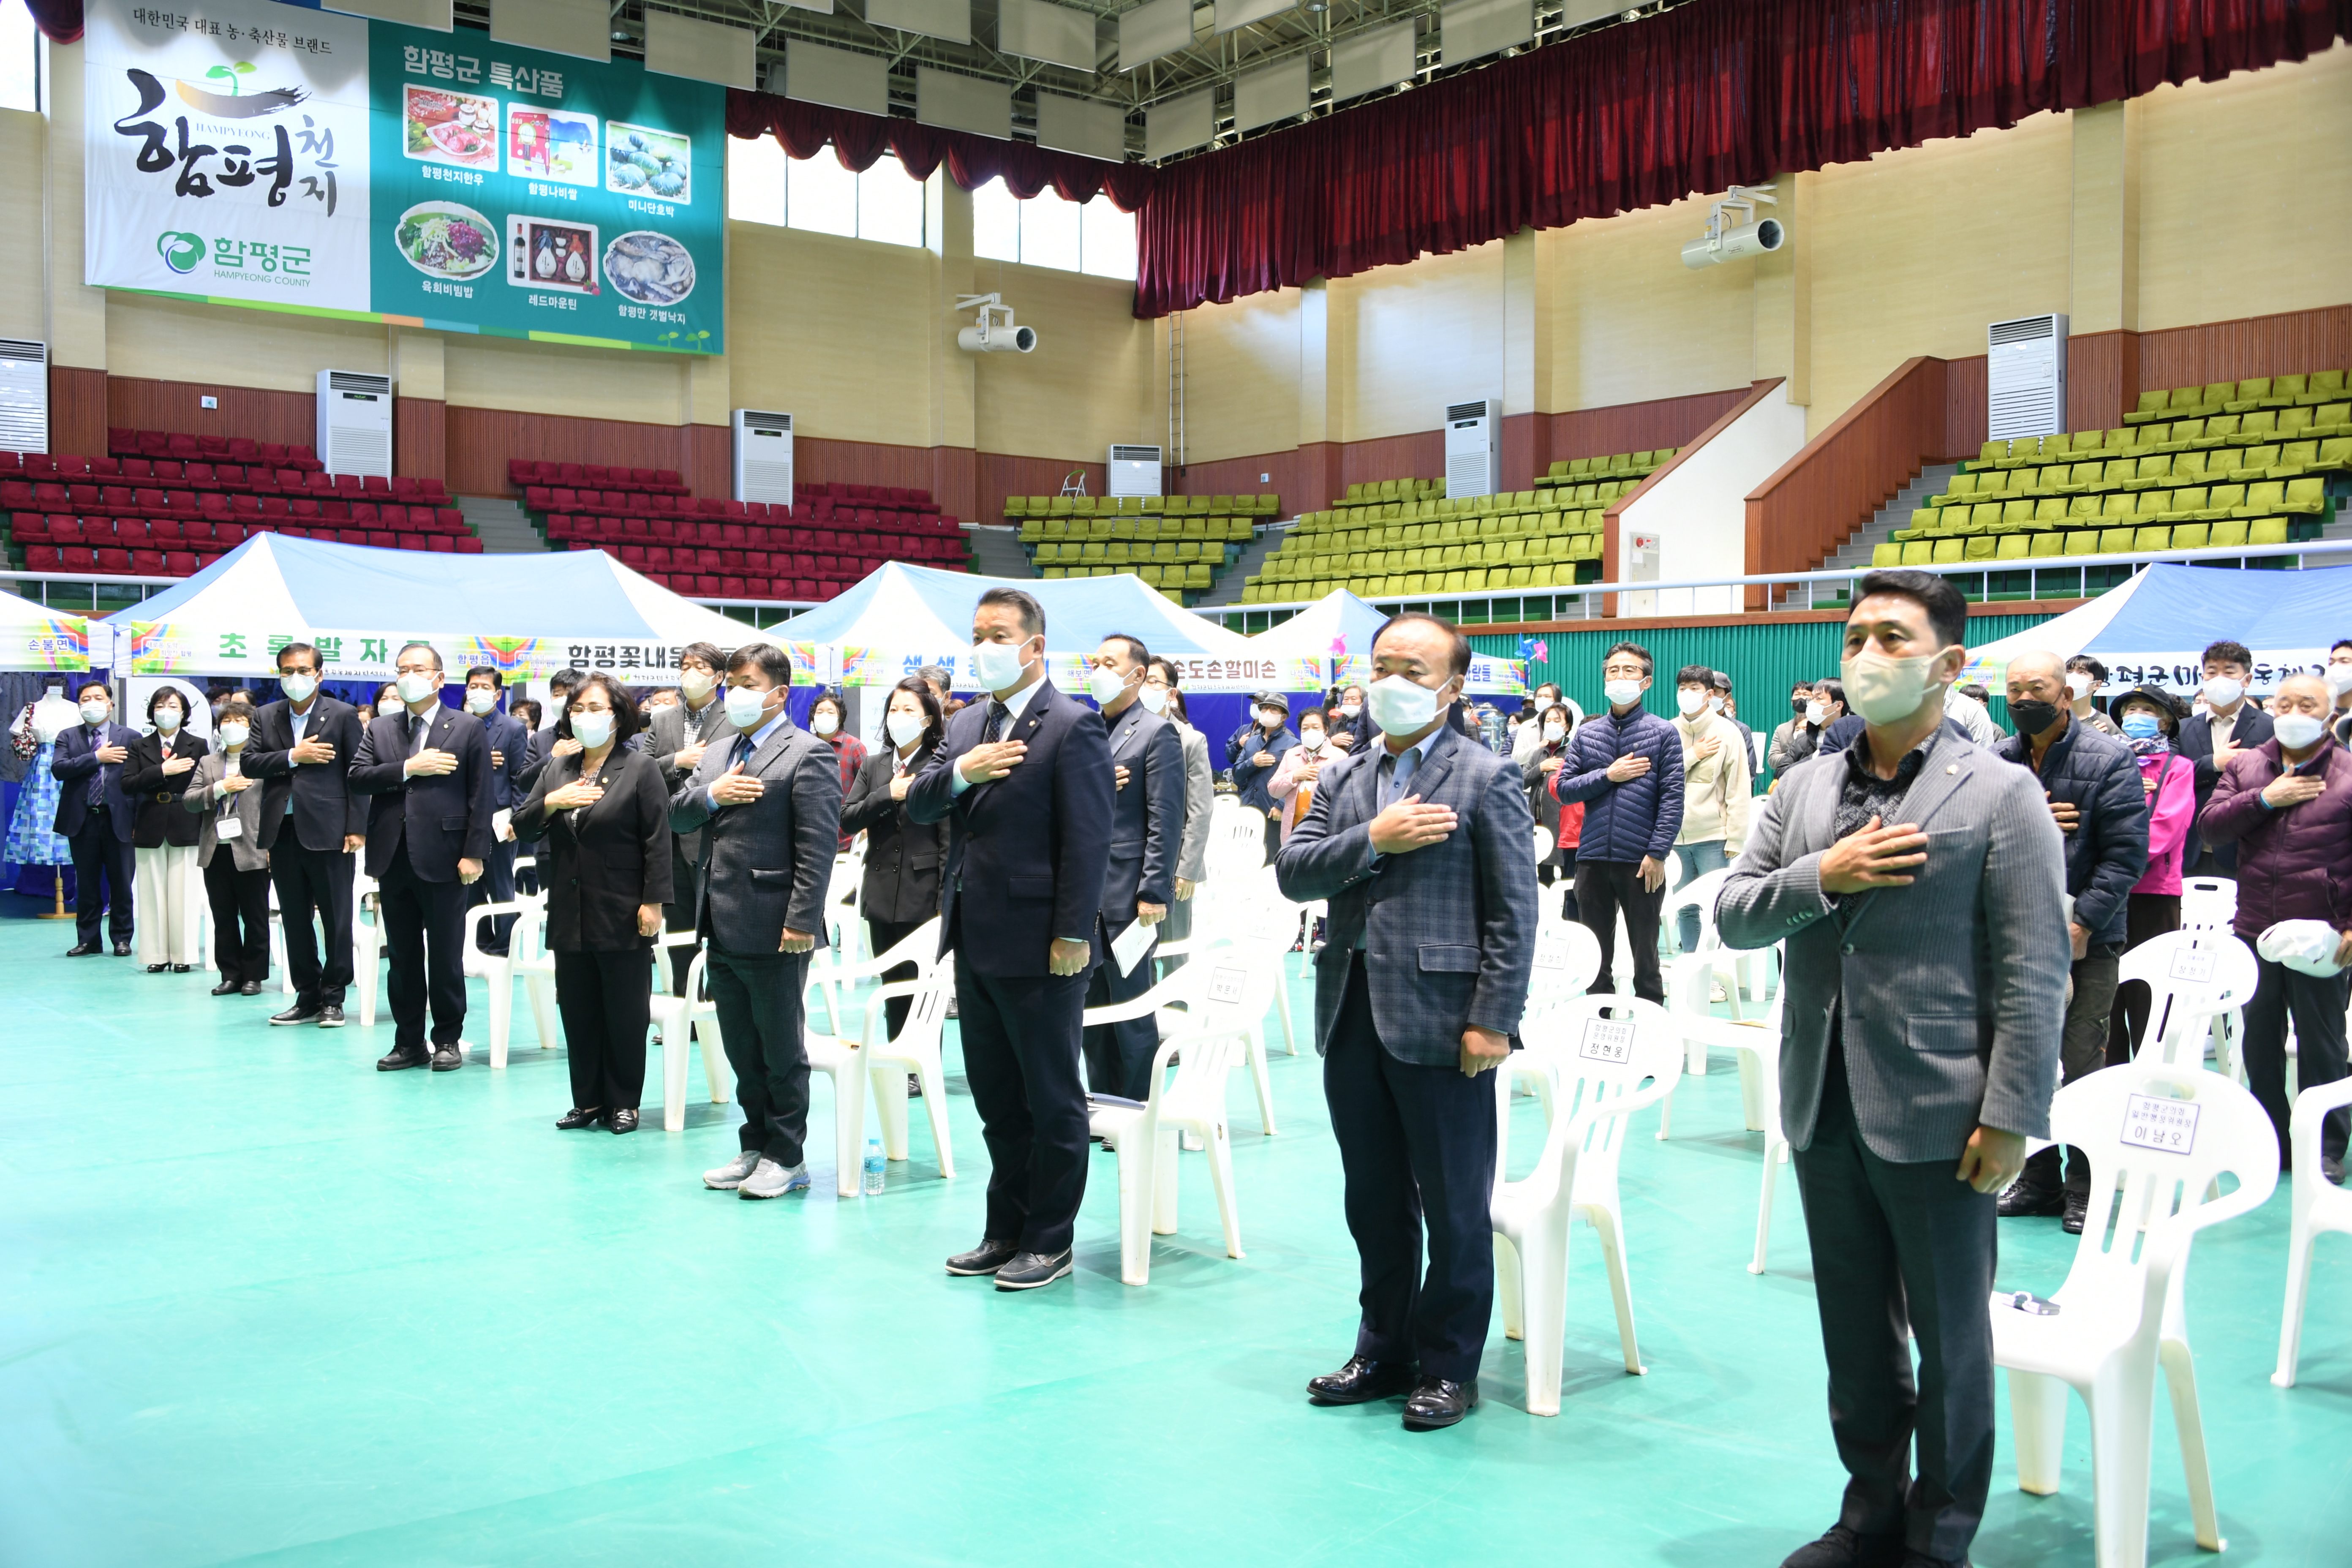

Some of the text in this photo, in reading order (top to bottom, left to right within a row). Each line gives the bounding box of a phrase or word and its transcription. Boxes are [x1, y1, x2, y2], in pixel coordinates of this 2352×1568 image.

[133, 8, 333, 55] 대한민국 대표 농·축산물 브랜드
[403, 45, 564, 99] 함평군 특산품
[196, 122, 271, 141] HAMPYEONG
[422, 165, 485, 186] 함평천지한우
[528, 182, 578, 201] 함평나비쌀
[628, 199, 675, 218] 미니단호박
[214, 237, 311, 276] 함평군
[214, 269, 311, 288] HAMPYEONG COUNTY
[422, 280, 474, 299] 육회비빔밥
[528, 294, 577, 311] 레드마운틴
[618, 304, 686, 326] 함평만 갯벌낙지
[27, 638, 68, 651] 손불면
[457, 653, 490, 666] 함평읍
[1290, 668, 1310, 678] 나산면
[1593, 1032, 1625, 1043] 운영위원장
[1595, 1024, 1626, 1034] 함평군의회
[1590, 1043, 1622, 1058] 정현웅
[2142, 1101, 2185, 1116] 함평군의회
[2134, 1125, 2181, 1146] 이남오
